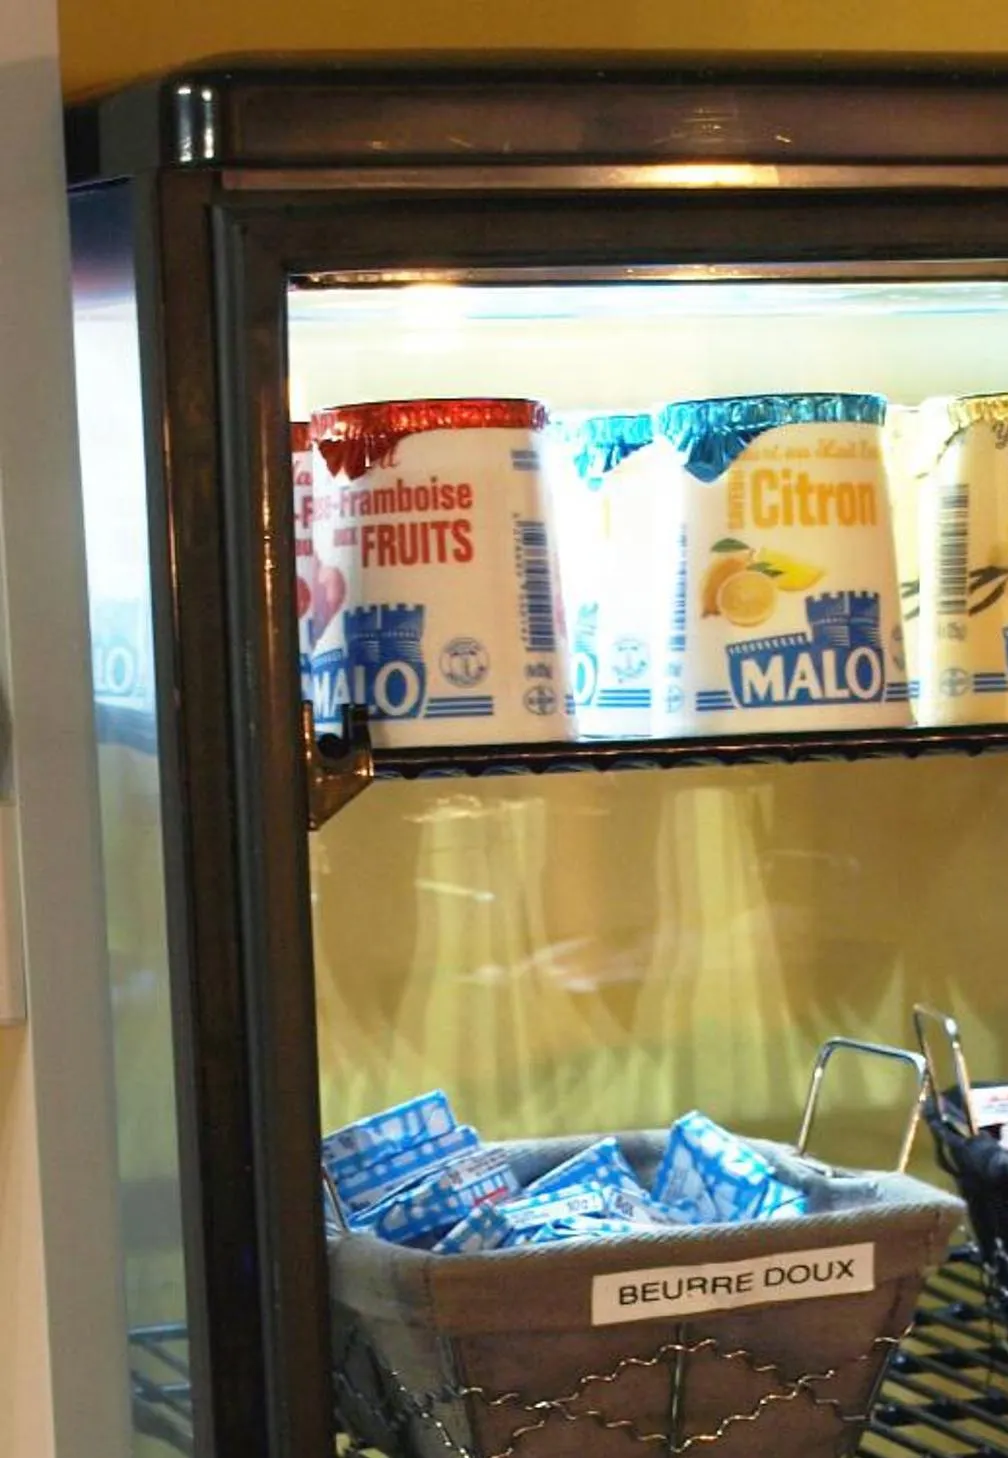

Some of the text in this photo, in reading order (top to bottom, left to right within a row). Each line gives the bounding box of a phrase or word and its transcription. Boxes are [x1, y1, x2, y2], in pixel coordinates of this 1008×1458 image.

[751, 467, 877, 529] Citron
[361, 519, 475, 568] FRUITS
[739, 646, 882, 704] MALO
[619, 1257, 856, 1307] BEURRE DOUX
